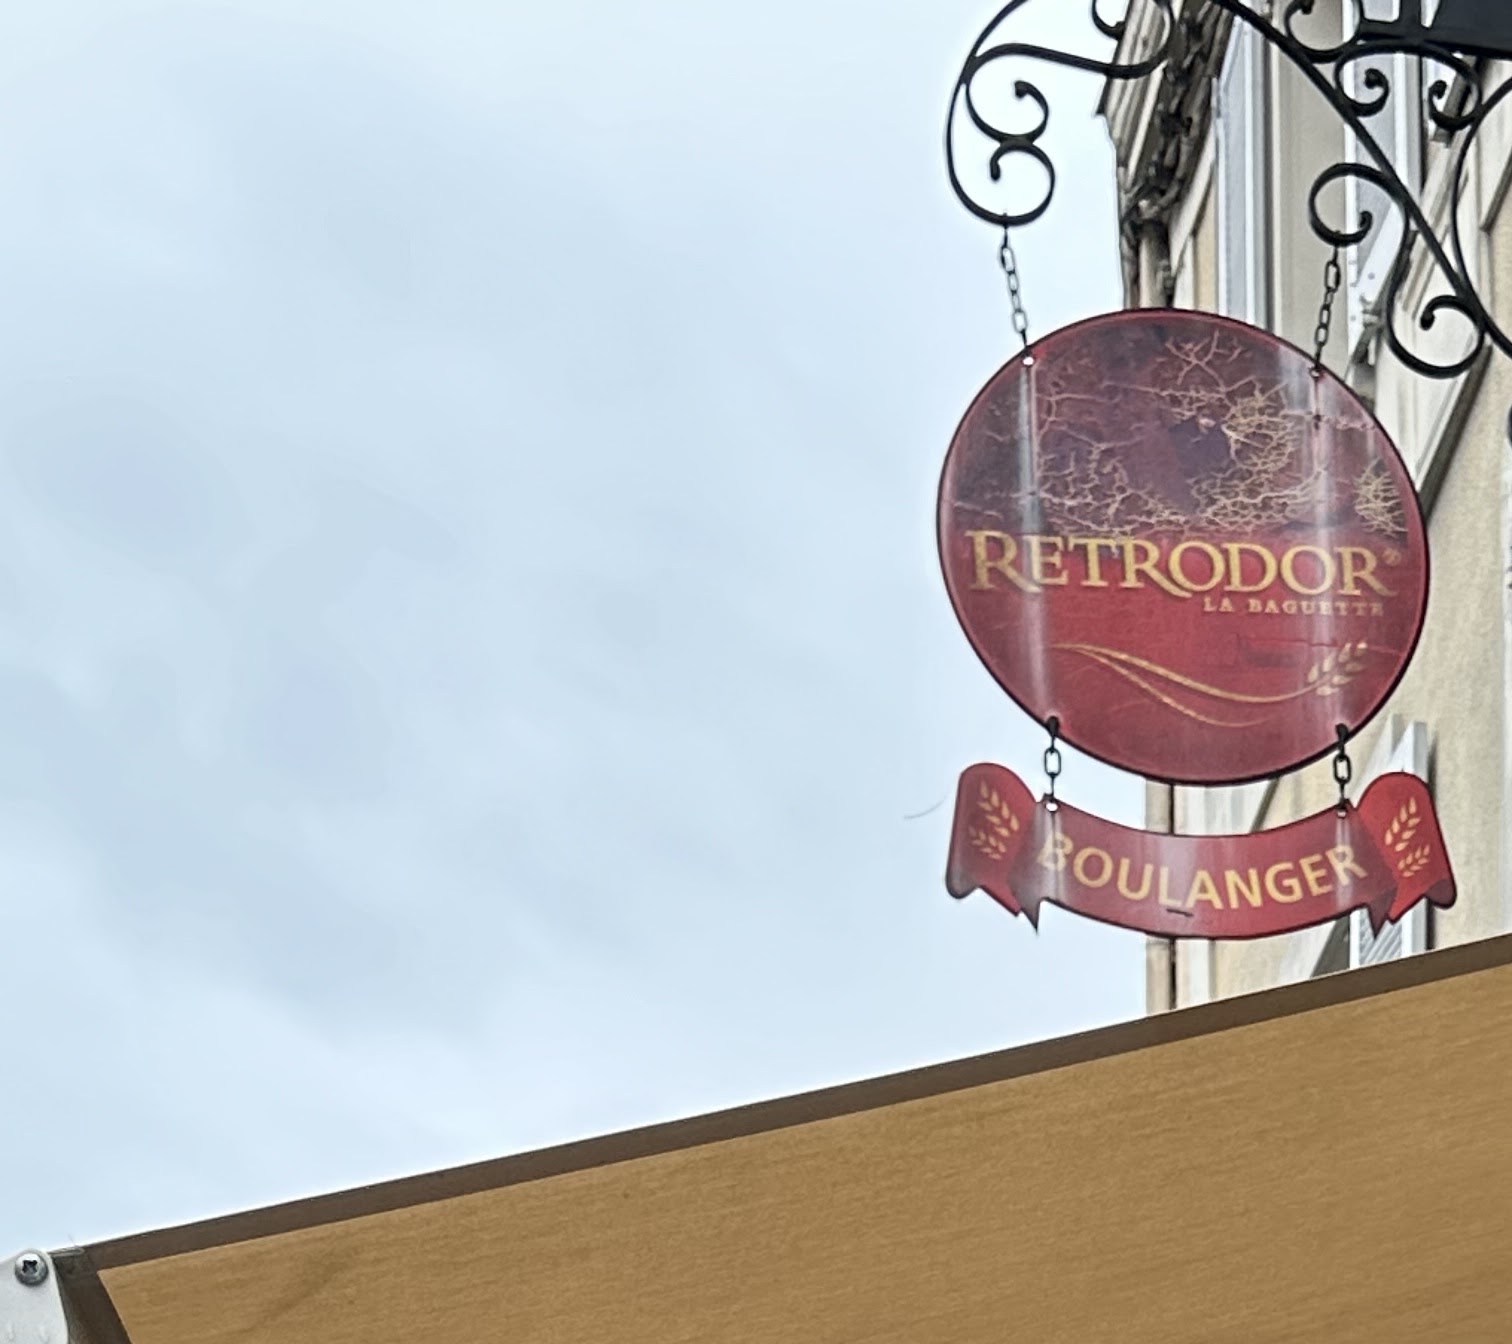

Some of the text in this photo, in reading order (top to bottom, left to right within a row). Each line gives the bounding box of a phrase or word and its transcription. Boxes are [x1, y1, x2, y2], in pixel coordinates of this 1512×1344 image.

[964, 529, 1399, 599] RETRODOR
[1203, 598, 1385, 616] LA BAGUETTE
[1035, 831, 1368, 910] BOULANGER
